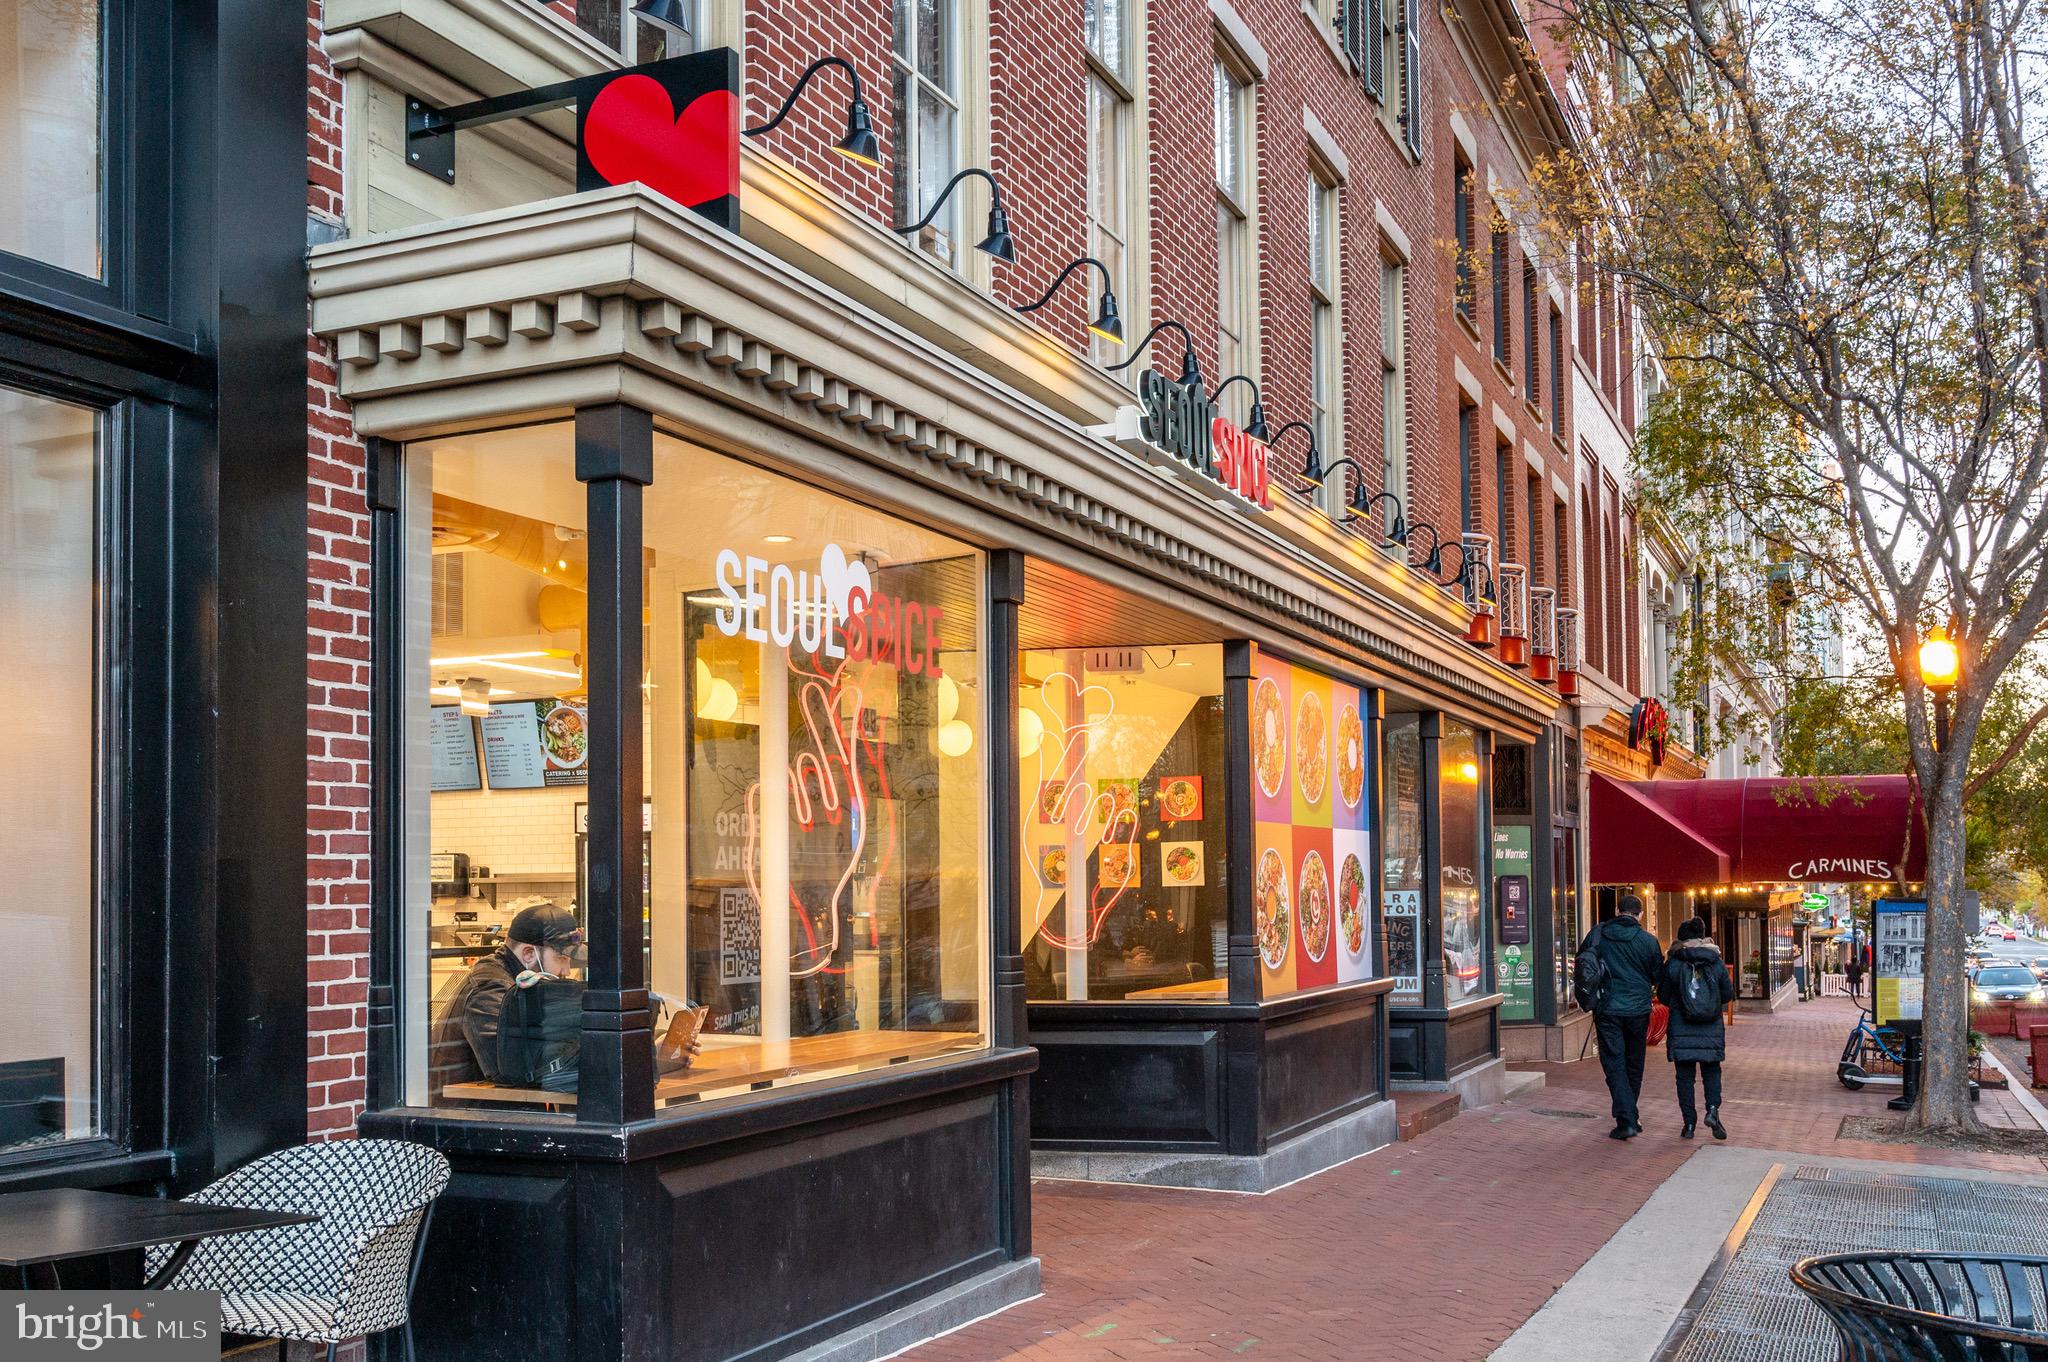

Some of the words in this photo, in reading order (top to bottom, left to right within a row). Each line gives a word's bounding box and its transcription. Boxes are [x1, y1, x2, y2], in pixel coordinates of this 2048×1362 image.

[1212, 417, 1275, 511] SPICE
[715, 548, 845, 660] SEOUL
[847, 585, 944, 680] SPICE
[715, 812, 761, 837] ORDE
[714, 846, 761, 870] AHEA
[1495, 848, 1504, 859] No
[1504, 848, 1529, 859] Worries
[1385, 905, 1417, 914] TON
[1389, 941, 1413, 951] ERS
[1395, 978, 1417, 989] UM
[714, 1013, 732, 1030] SCAN
[734, 1008, 748, 1024] THIS
